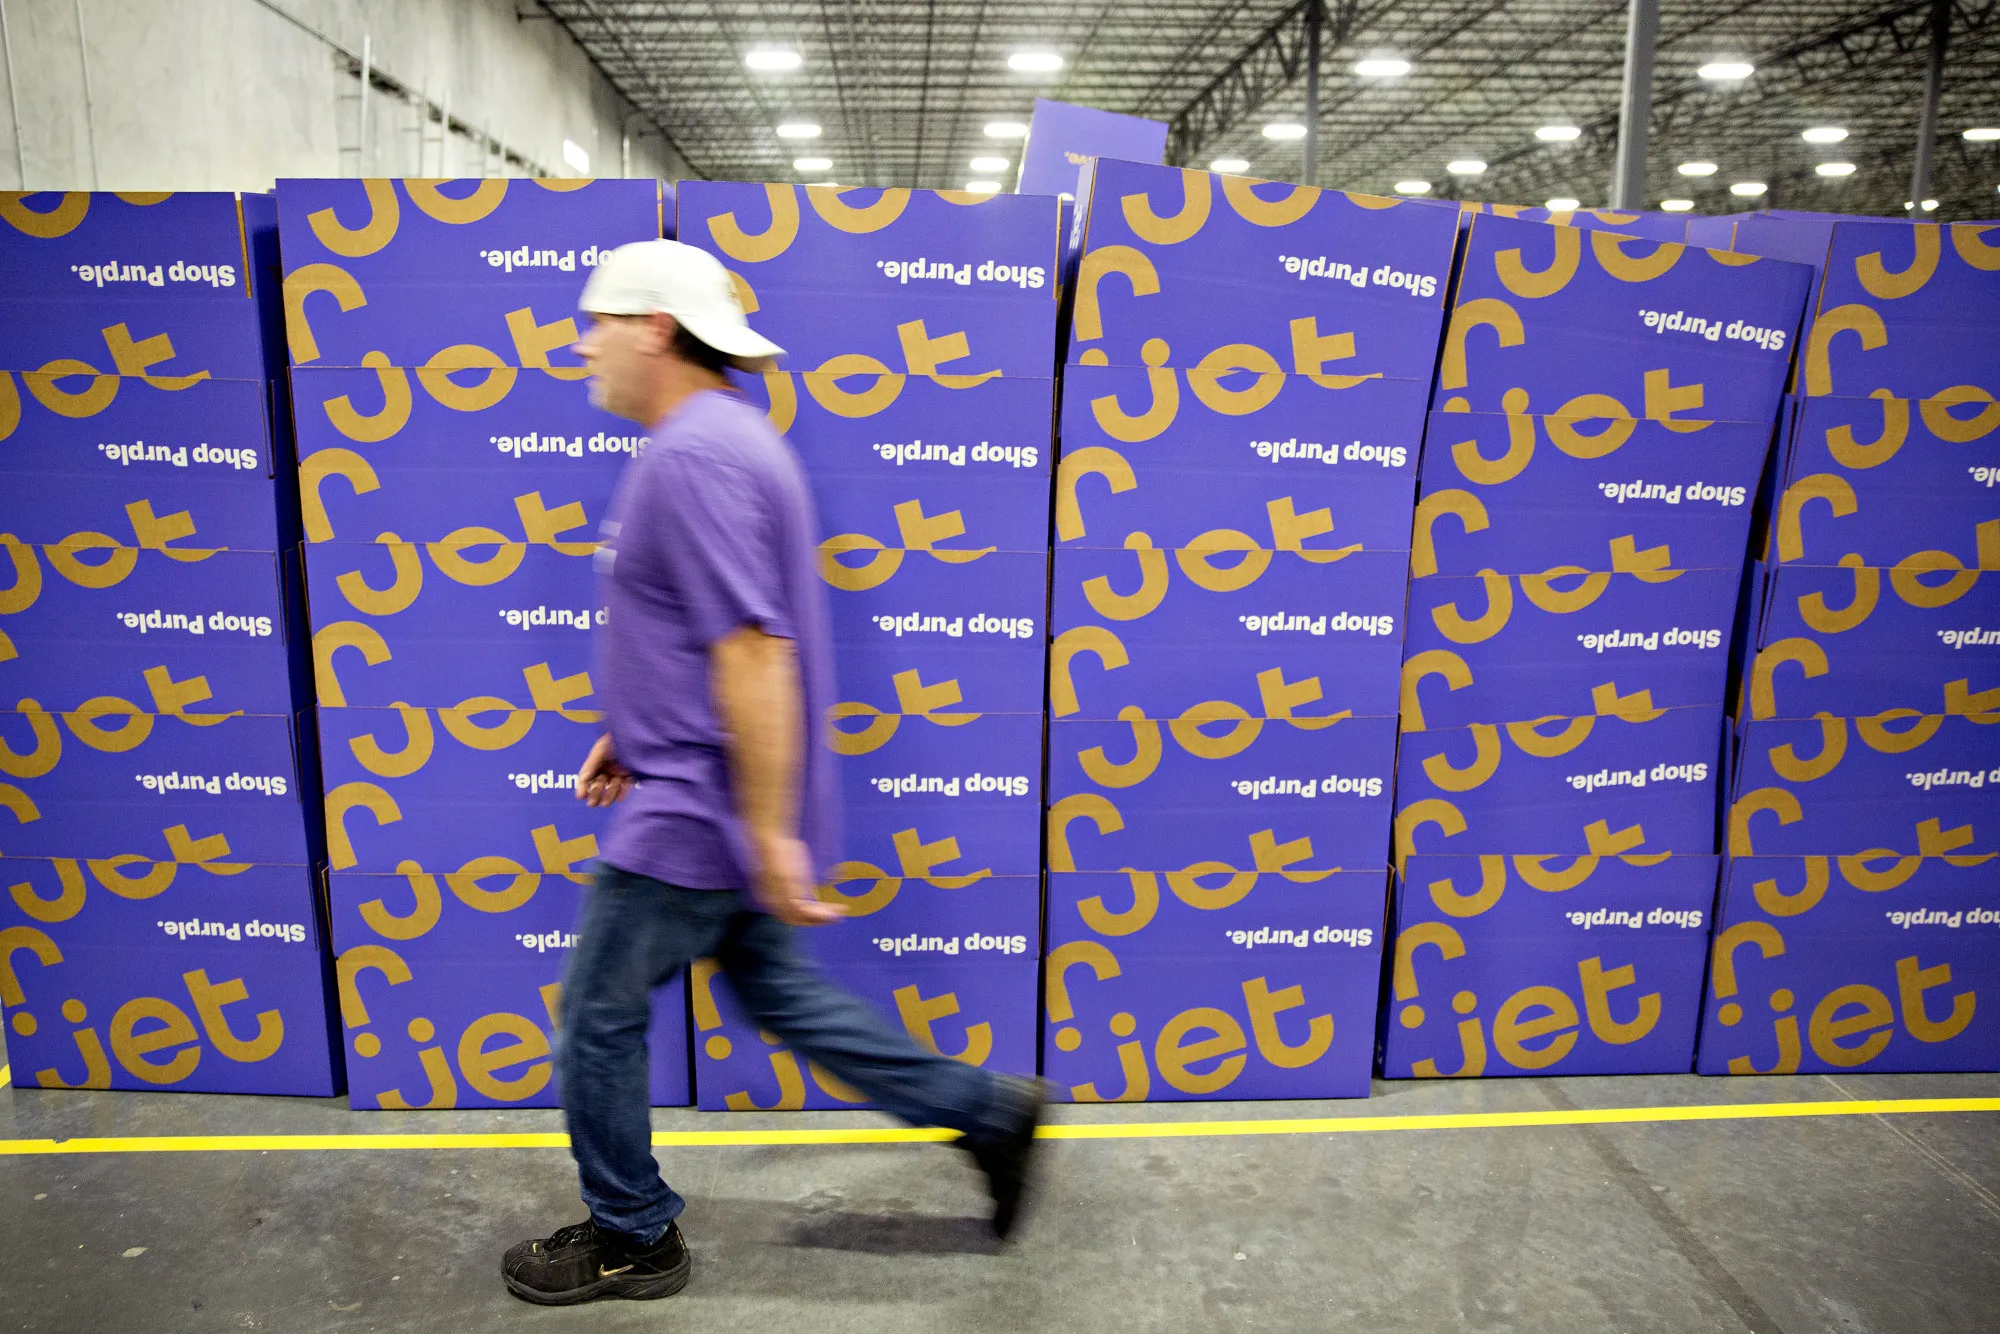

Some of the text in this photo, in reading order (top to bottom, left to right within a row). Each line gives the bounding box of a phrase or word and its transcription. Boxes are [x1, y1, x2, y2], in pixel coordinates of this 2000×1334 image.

[479, 245, 614, 273] op Purple.
[72, 261, 237, 289] Shop Purple.
[877, 258, 1047, 290] Shop Purple.
[1279, 256, 1438, 299] Shop Purple.
[1639, 310, 1787, 352] Shop Purple.
[98, 441, 259, 471] Shop Purple.
[489, 432, 585, 461] Purple.
[873, 440, 1040, 469] Shop Purple.
[1250, 439, 1408, 469] Shop Purple.
[1599, 480, 1747, 508] Shop Purple.
[117, 610, 274, 638] Shop Purple.
[499, 606, 592, 632] Purple.
[873, 612, 1035, 640] Shop Purple.
[1239, 612, 1395, 638] Shop Purple.
[1578, 628, 1723, 655] Shop Purple.
[1938, 628, 2000, 651] urple.
[136, 772, 289, 797] Shop Purple.
[507, 769, 578, 795] urple.
[872, 773, 1030, 799] Shop Purple.
[1232, 775, 1384, 801] Shop Purple.
[1567, 764, 1709, 794] Shop Purple.
[1906, 769, 1986, 792] Purple.
[158, 919, 307, 944] Shop Purple.
[1566, 908, 1704, 931] Shop Purple.
[1886, 909, 1964, 930] Purple.
[873, 933, 1028, 958] Shop Purple.
[1226, 926, 1374, 950] Shop Purple.
[36, 969, 284, 1089] jet
[1412, 956, 1661, 1078] jet
[1728, 955, 1976, 1076] jet
[377, 982, 562, 1109] je
[725, 984, 993, 1110] jt
[1071, 976, 1333, 1102] jet
